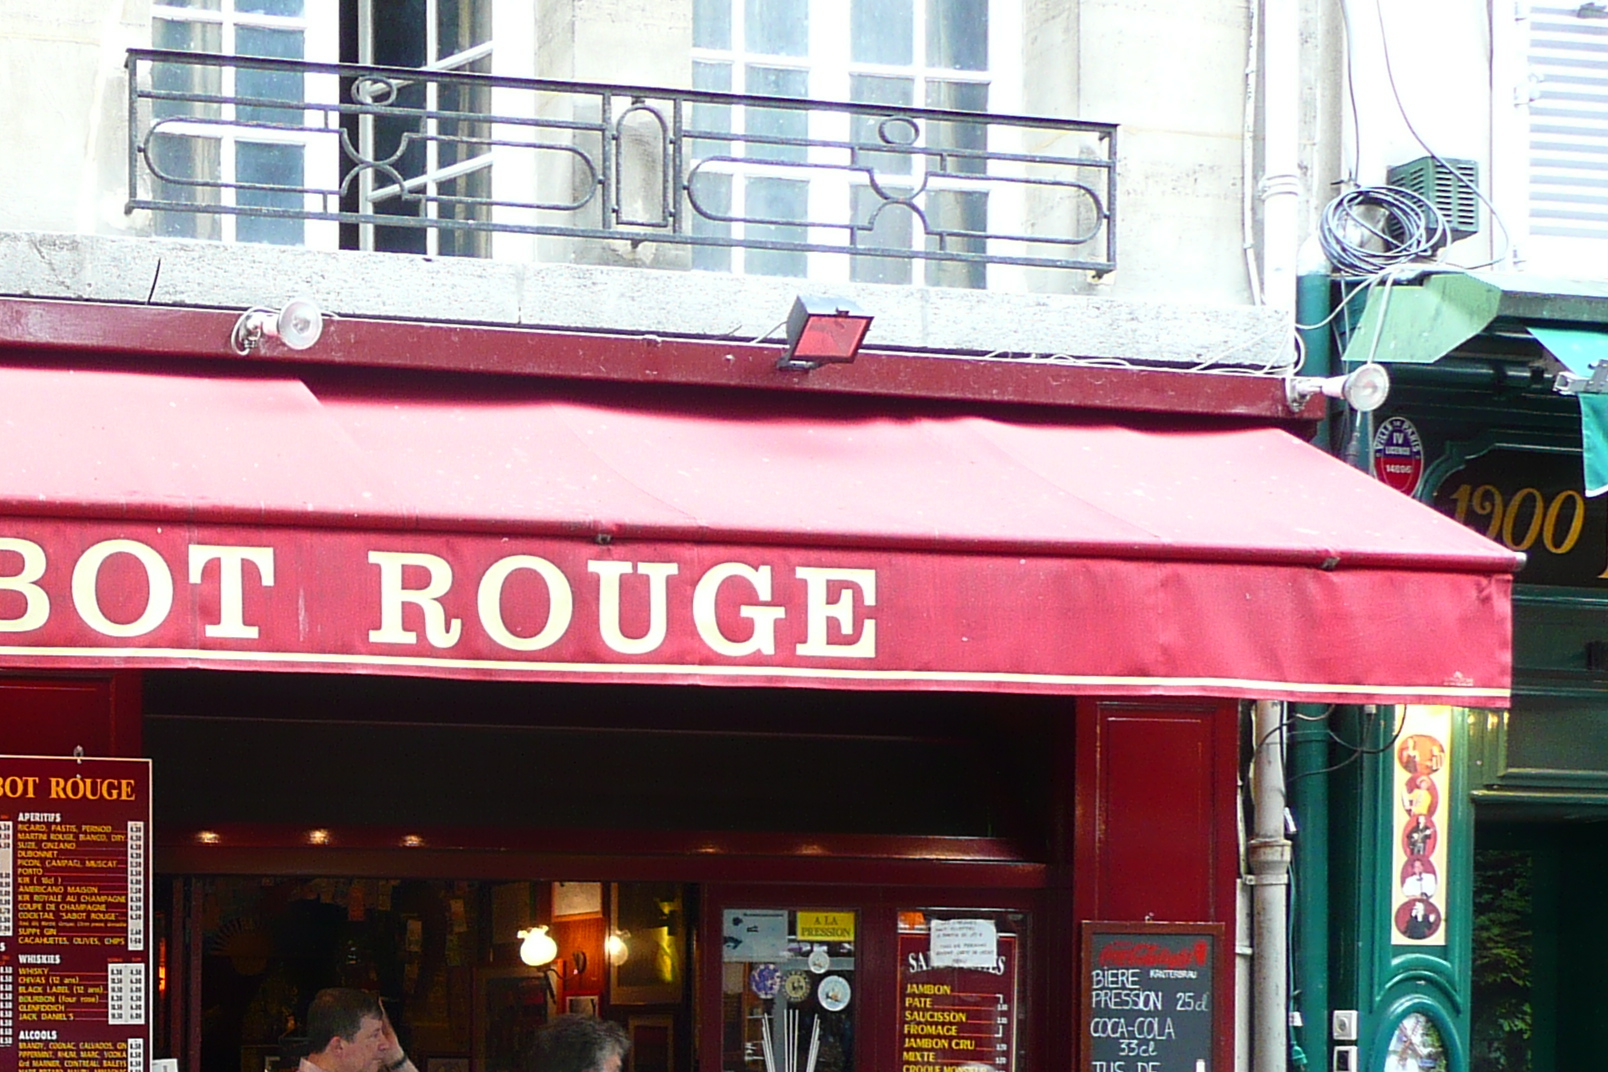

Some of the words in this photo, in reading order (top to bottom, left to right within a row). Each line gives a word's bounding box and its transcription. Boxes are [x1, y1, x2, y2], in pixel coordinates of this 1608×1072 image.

[1374, 422, 1392, 449] VILLE
[1402, 421, 1421, 451] PARIS
[1393, 432, 1404, 444] IV
[1450, 484, 1585, 555] 1900
[367, 550, 876, 658] ROUGE
[49, 777, 136, 800] ROUGE
[18, 812, 61, 822] APERITIFS
[814, 916, 821, 925] A
[824, 916, 838, 925] LA
[801, 927, 851, 937] PRESSION
[18, 955, 60, 964] WHISKIES
[1150, 970, 1197, 979] KANTERBRAU
[906, 984, 951, 995] JAMBON
[905, 997, 933, 1008] PATE
[1092, 990, 1162, 1011] PRESSION
[1176, 992, 1210, 1011] 25cl
[905, 1011, 966, 1022] SAUCISSON
[904, 1024, 958, 1036] FROMAGE
[1091, 1018, 1175, 1040] COCA-COLA
[18, 1031, 57, 1040] ALCOOLS
[904, 1038, 949, 1049] JAMBON
[952, 1040, 975, 1050] CRU
[1118, 1040, 1157, 1056] 33cl
[903, 1051, 936, 1062] MIXTE
